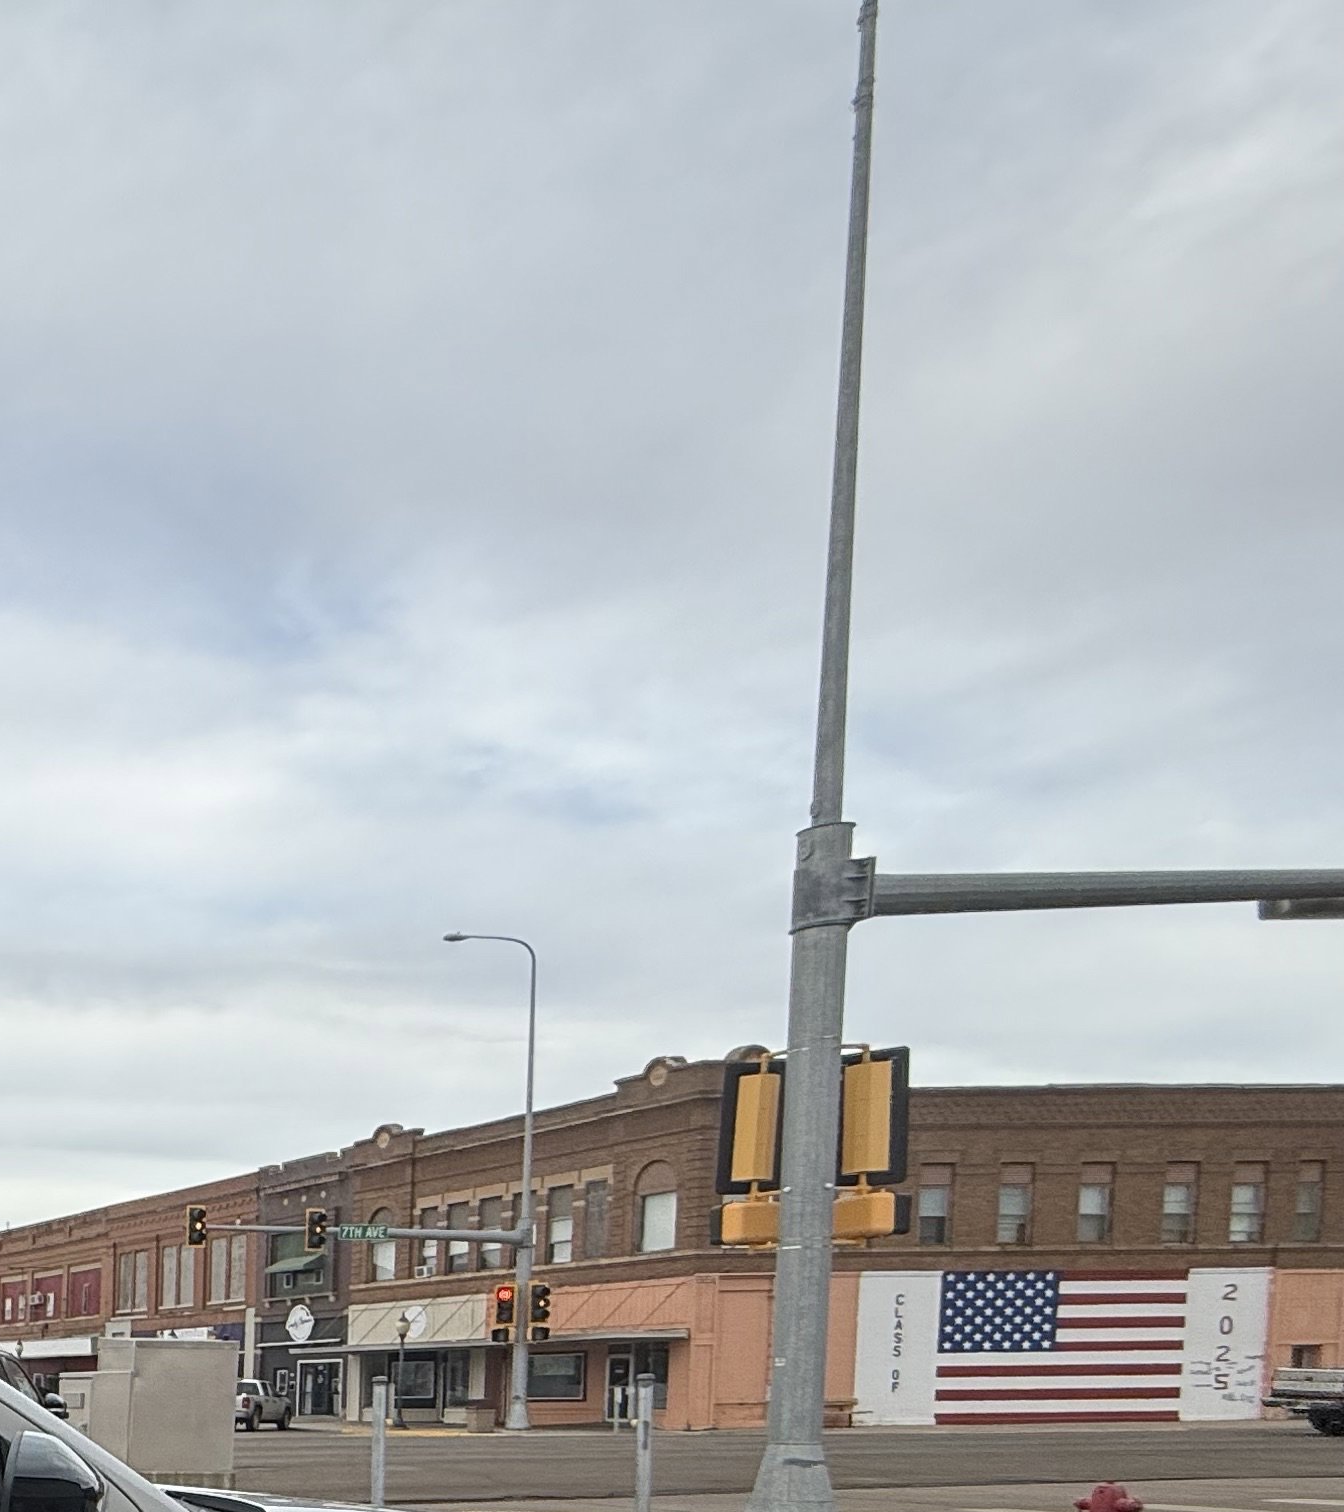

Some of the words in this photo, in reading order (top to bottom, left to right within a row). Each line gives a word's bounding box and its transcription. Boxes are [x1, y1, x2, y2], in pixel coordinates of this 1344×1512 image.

[341, 1226, 363, 1238] 7TH
[365, 1226, 387, 1238] AVE
[892, 1293, 906, 1358] CLASS
[1212, 1283, 1239, 1390] 2025
[891, 1368, 901, 1393] OF
